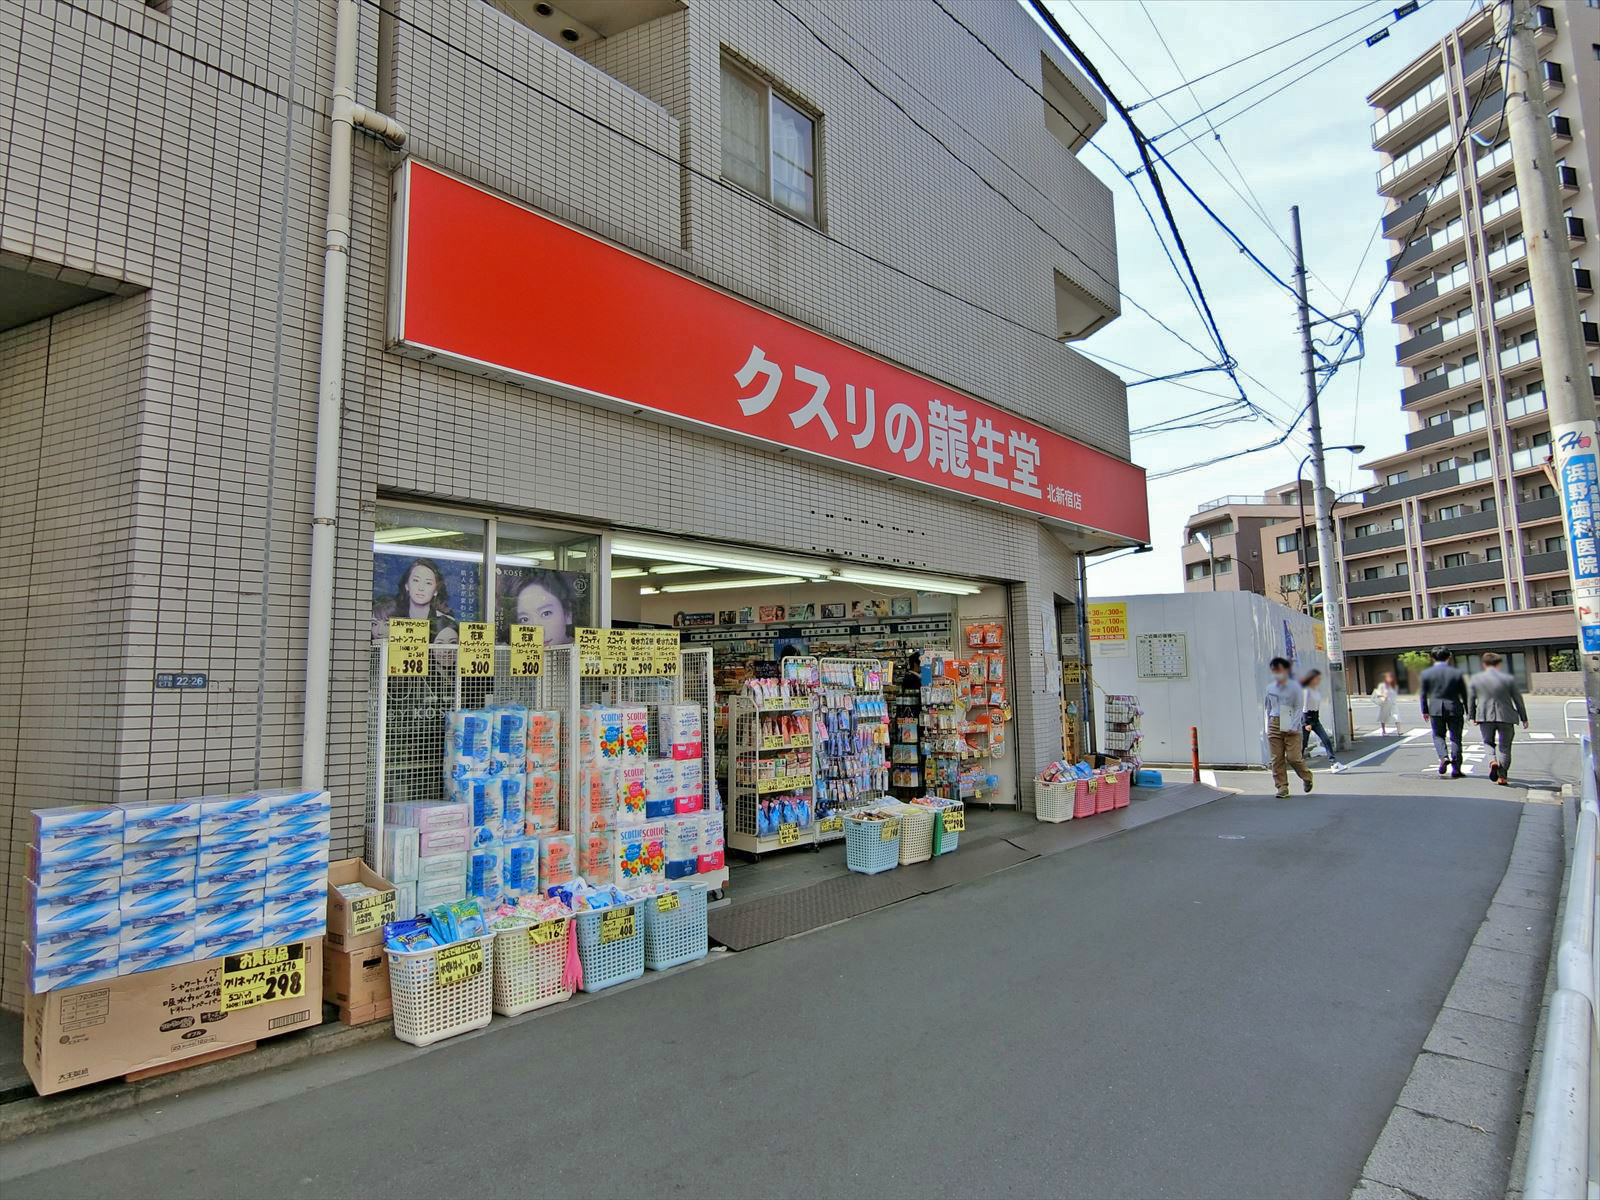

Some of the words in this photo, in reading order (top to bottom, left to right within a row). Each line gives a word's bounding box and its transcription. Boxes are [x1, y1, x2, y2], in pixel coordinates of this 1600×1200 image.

[734, 345, 1042, 499] クスリの龍生堂
[1046, 483, 1082, 511] 北新宿店
[1566, 463, 1599, 576] 浜野歯科医院
[402, 659, 423, 674] 398
[471, 660, 490, 674] 300
[522, 661, 539, 674] 300
[612, 663, 627, 675] 375
[638, 663, 652, 674] 399
[664, 662, 677, 674] 399
[380, 911, 396, 927] 298
[619, 924, 633, 937] 408
[239, 946, 289, 970] お買得品
[464, 961, 483, 977] 108
[224, 971, 266, 990] クリネックス
[262, 971, 302, 1000] 298
